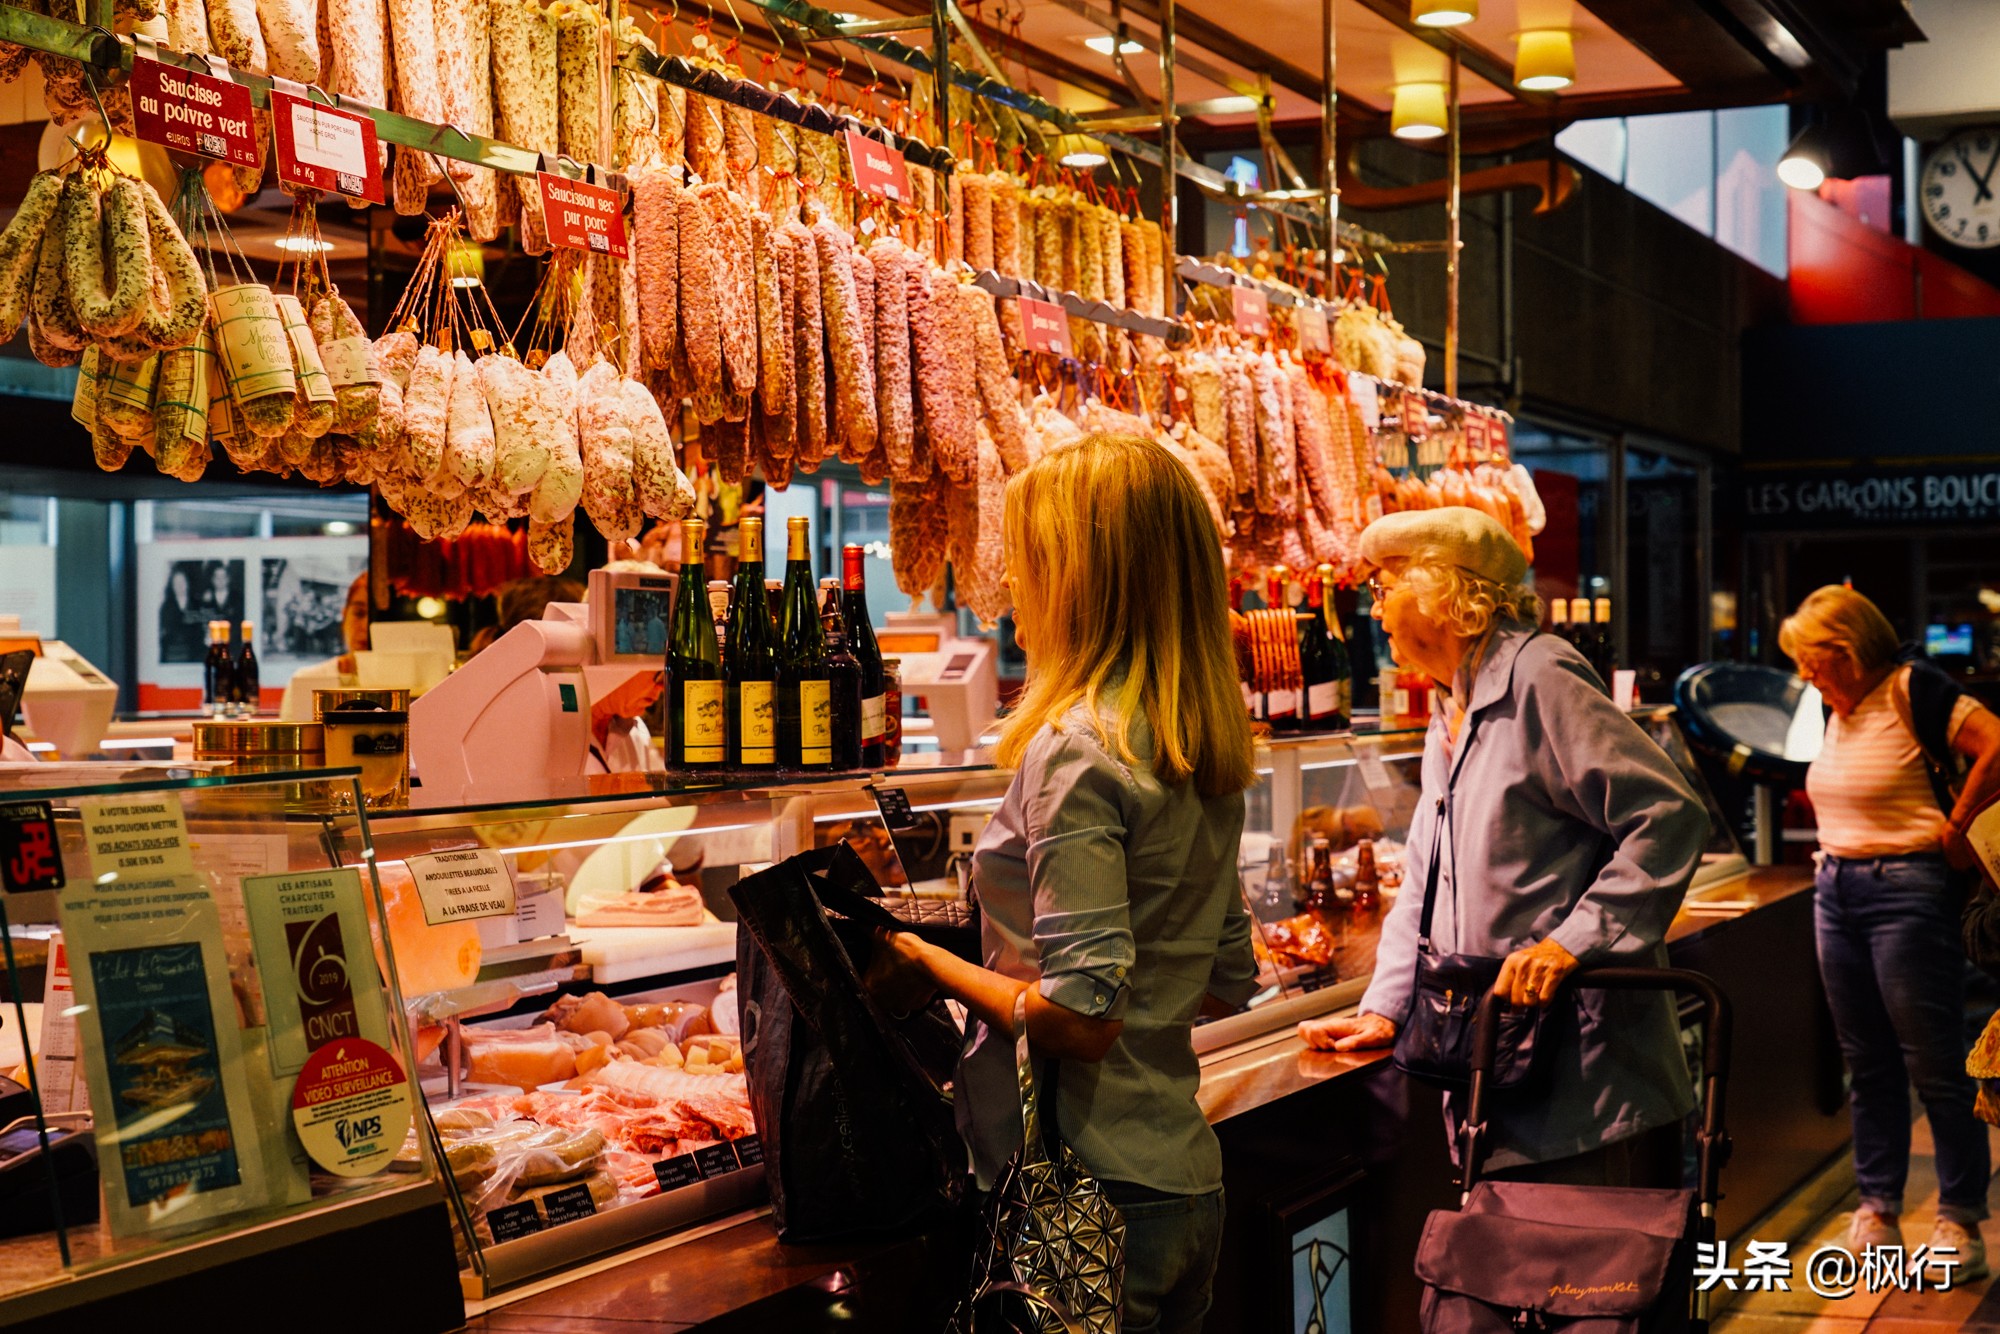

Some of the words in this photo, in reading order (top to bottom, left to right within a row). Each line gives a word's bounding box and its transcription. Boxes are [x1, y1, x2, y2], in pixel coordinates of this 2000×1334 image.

[160, 72, 222, 107] Saucisse
[140, 95, 158, 116] au
[164, 102, 212, 129] poivre
[218, 116, 247, 138] vert
[297, 114, 320, 127] SAUCISSON
[322, 121, 332, 131] PUR
[331, 123, 342, 132] PORC
[324, 131, 336, 141] GROS
[233, 148, 242, 160] LE
[245, 151, 254, 162] KG
[293, 163, 301, 176] le
[305, 167, 314, 182] Kg
[547, 182, 595, 210] Saucisson
[597, 198, 614, 213] sec
[564, 210, 580, 227] pur
[584, 215, 607, 232] porc
[1748, 482, 1790, 515] LES
[1922, 473, 2000, 508] BOUC
[107, 806, 129, 816] VOTRE
[130, 804, 166, 815] DEMANDE
[92, 825, 114, 835] NOUS
[115, 822, 150, 833] POUVONS
[151, 819, 178, 830] METTRE
[96, 842, 112, 853] VOS
[434, 852, 479, 863] TRADITIONNELLES
[425, 869, 464, 881] ANDOUILLETTES
[464, 866, 498, 878] BEAUJOLAISES
[278, 881, 292, 893] LES
[294, 878, 333, 890] ARTISANS
[473, 884, 491, 893] FICELLE
[279, 890, 336, 904] CHARCUTIERS
[282, 904, 325, 917] TRAITEURS
[442, 907, 449, 916] A
[448, 906, 457, 916] LA
[457, 903, 480, 914] FRAISE
[480, 902, 488, 912] DE
[488, 900, 505, 910] VEAU
[318, 972, 339, 986] 2019
[308, 1011, 353, 1041] CNCT
[321, 1057, 370, 1081] ATTENTION
[303, 1086, 333, 1105] VIDEO
[333, 1071, 393, 1098] SURVEILLANCE
[353, 1115, 381, 1140] NPS
